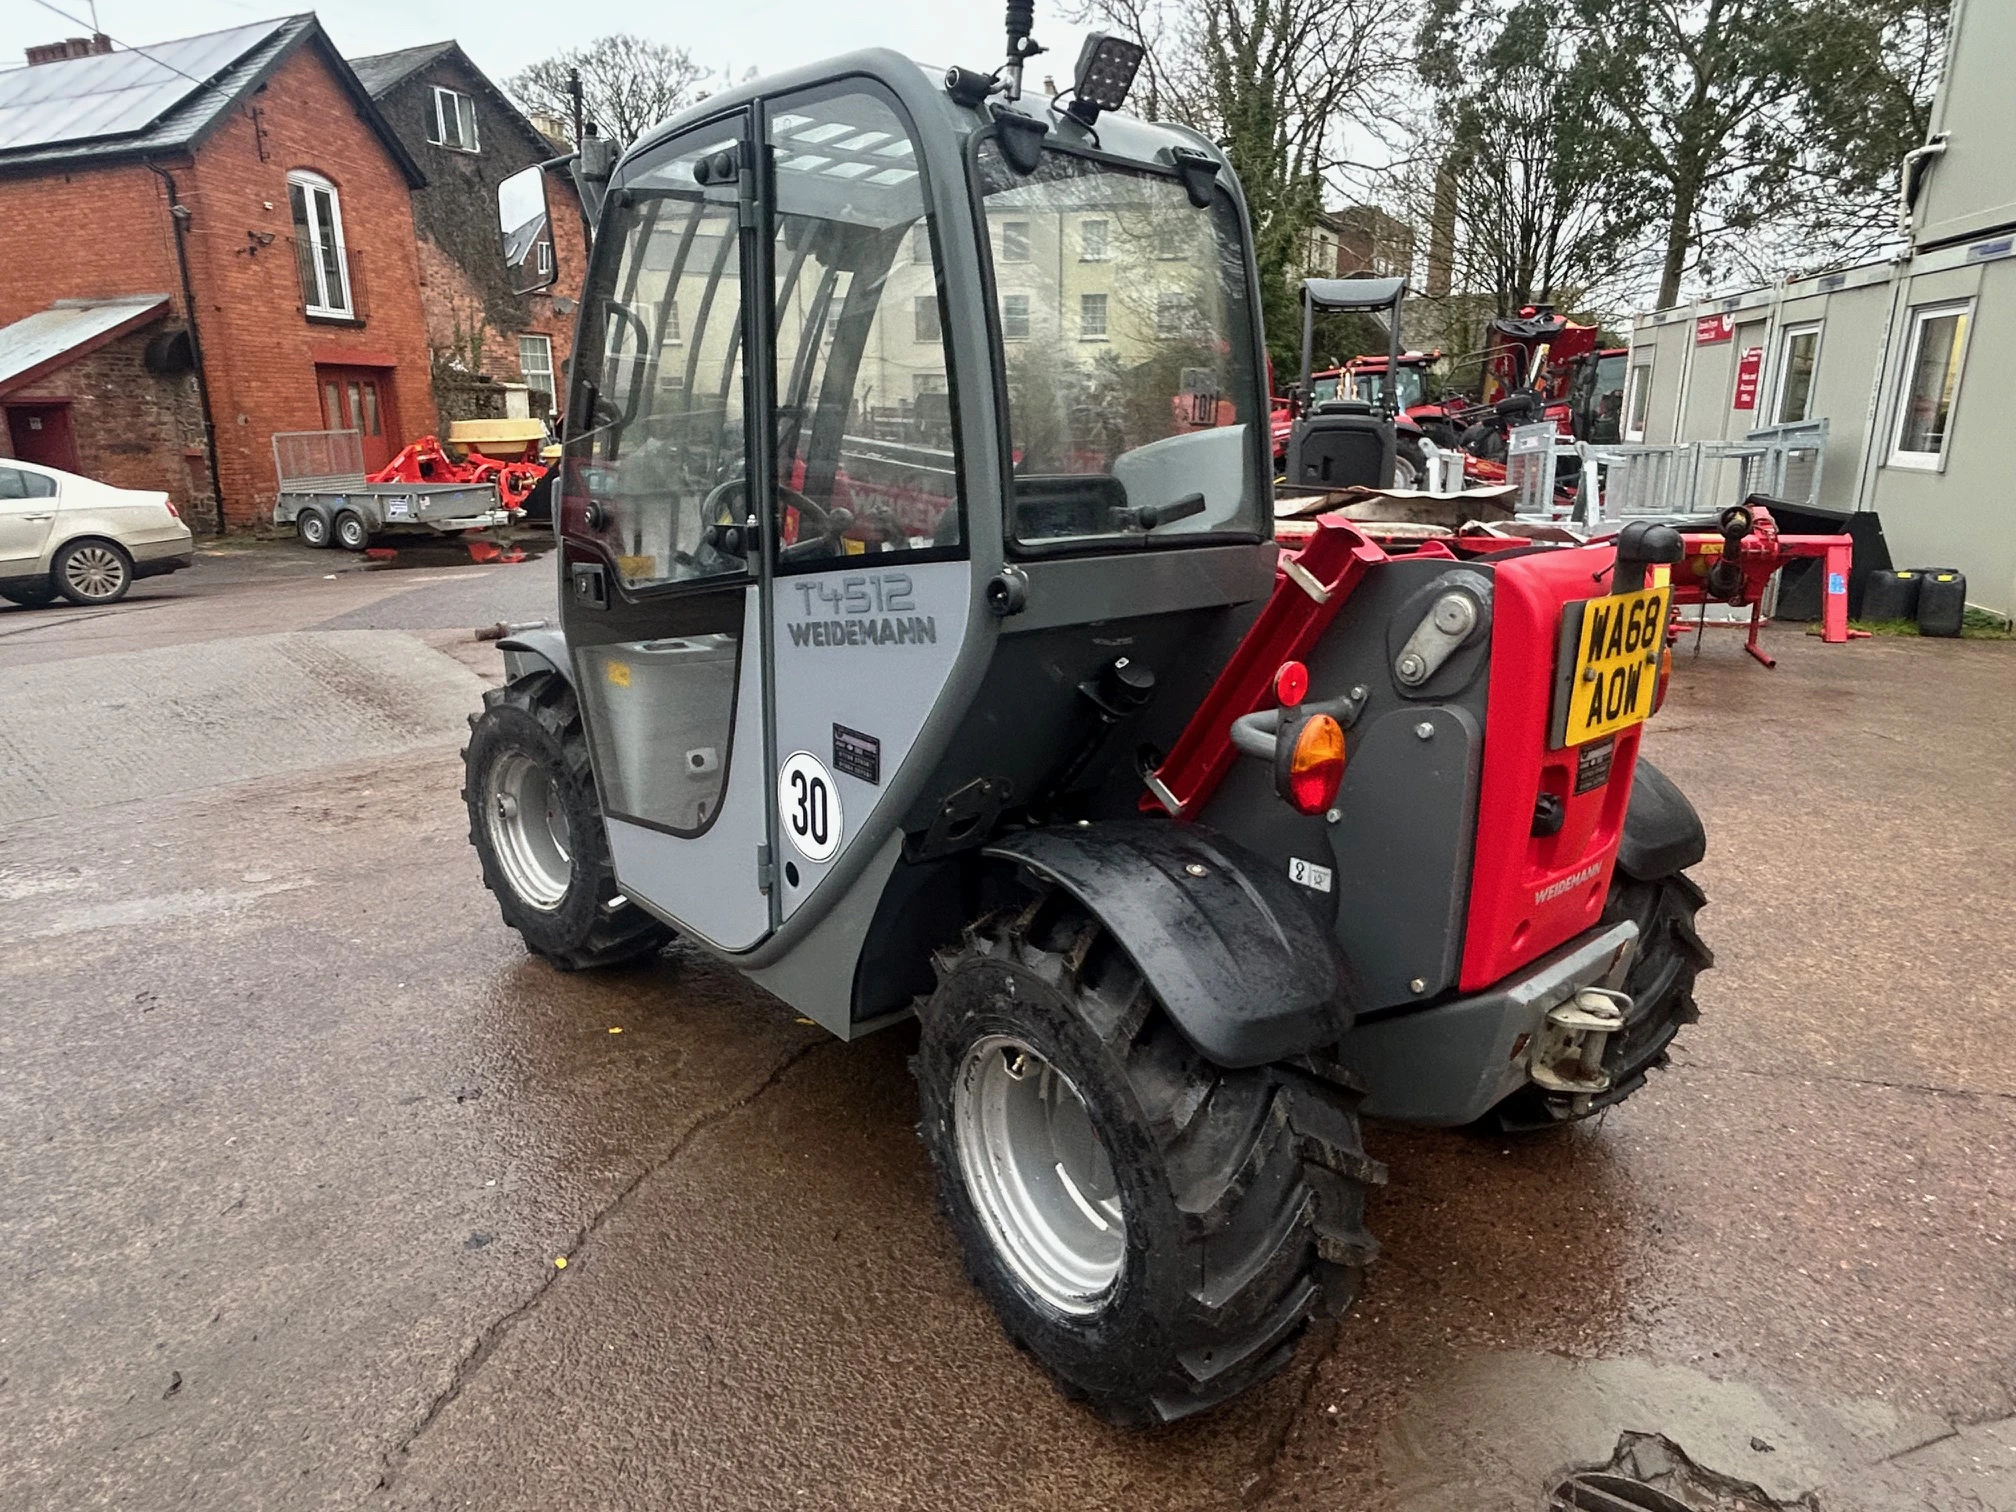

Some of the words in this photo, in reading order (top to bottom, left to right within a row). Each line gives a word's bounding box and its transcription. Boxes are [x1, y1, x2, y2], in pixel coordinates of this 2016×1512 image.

[794, 572, 916, 616] T4512
[786, 615, 937, 648] WEIDEMANN
[1586, 595, 1661, 663] WA68
[1585, 660, 1643, 728] AOW
[791, 769, 828, 845] 30
[1534, 860, 1603, 906] WEIDEMANN
